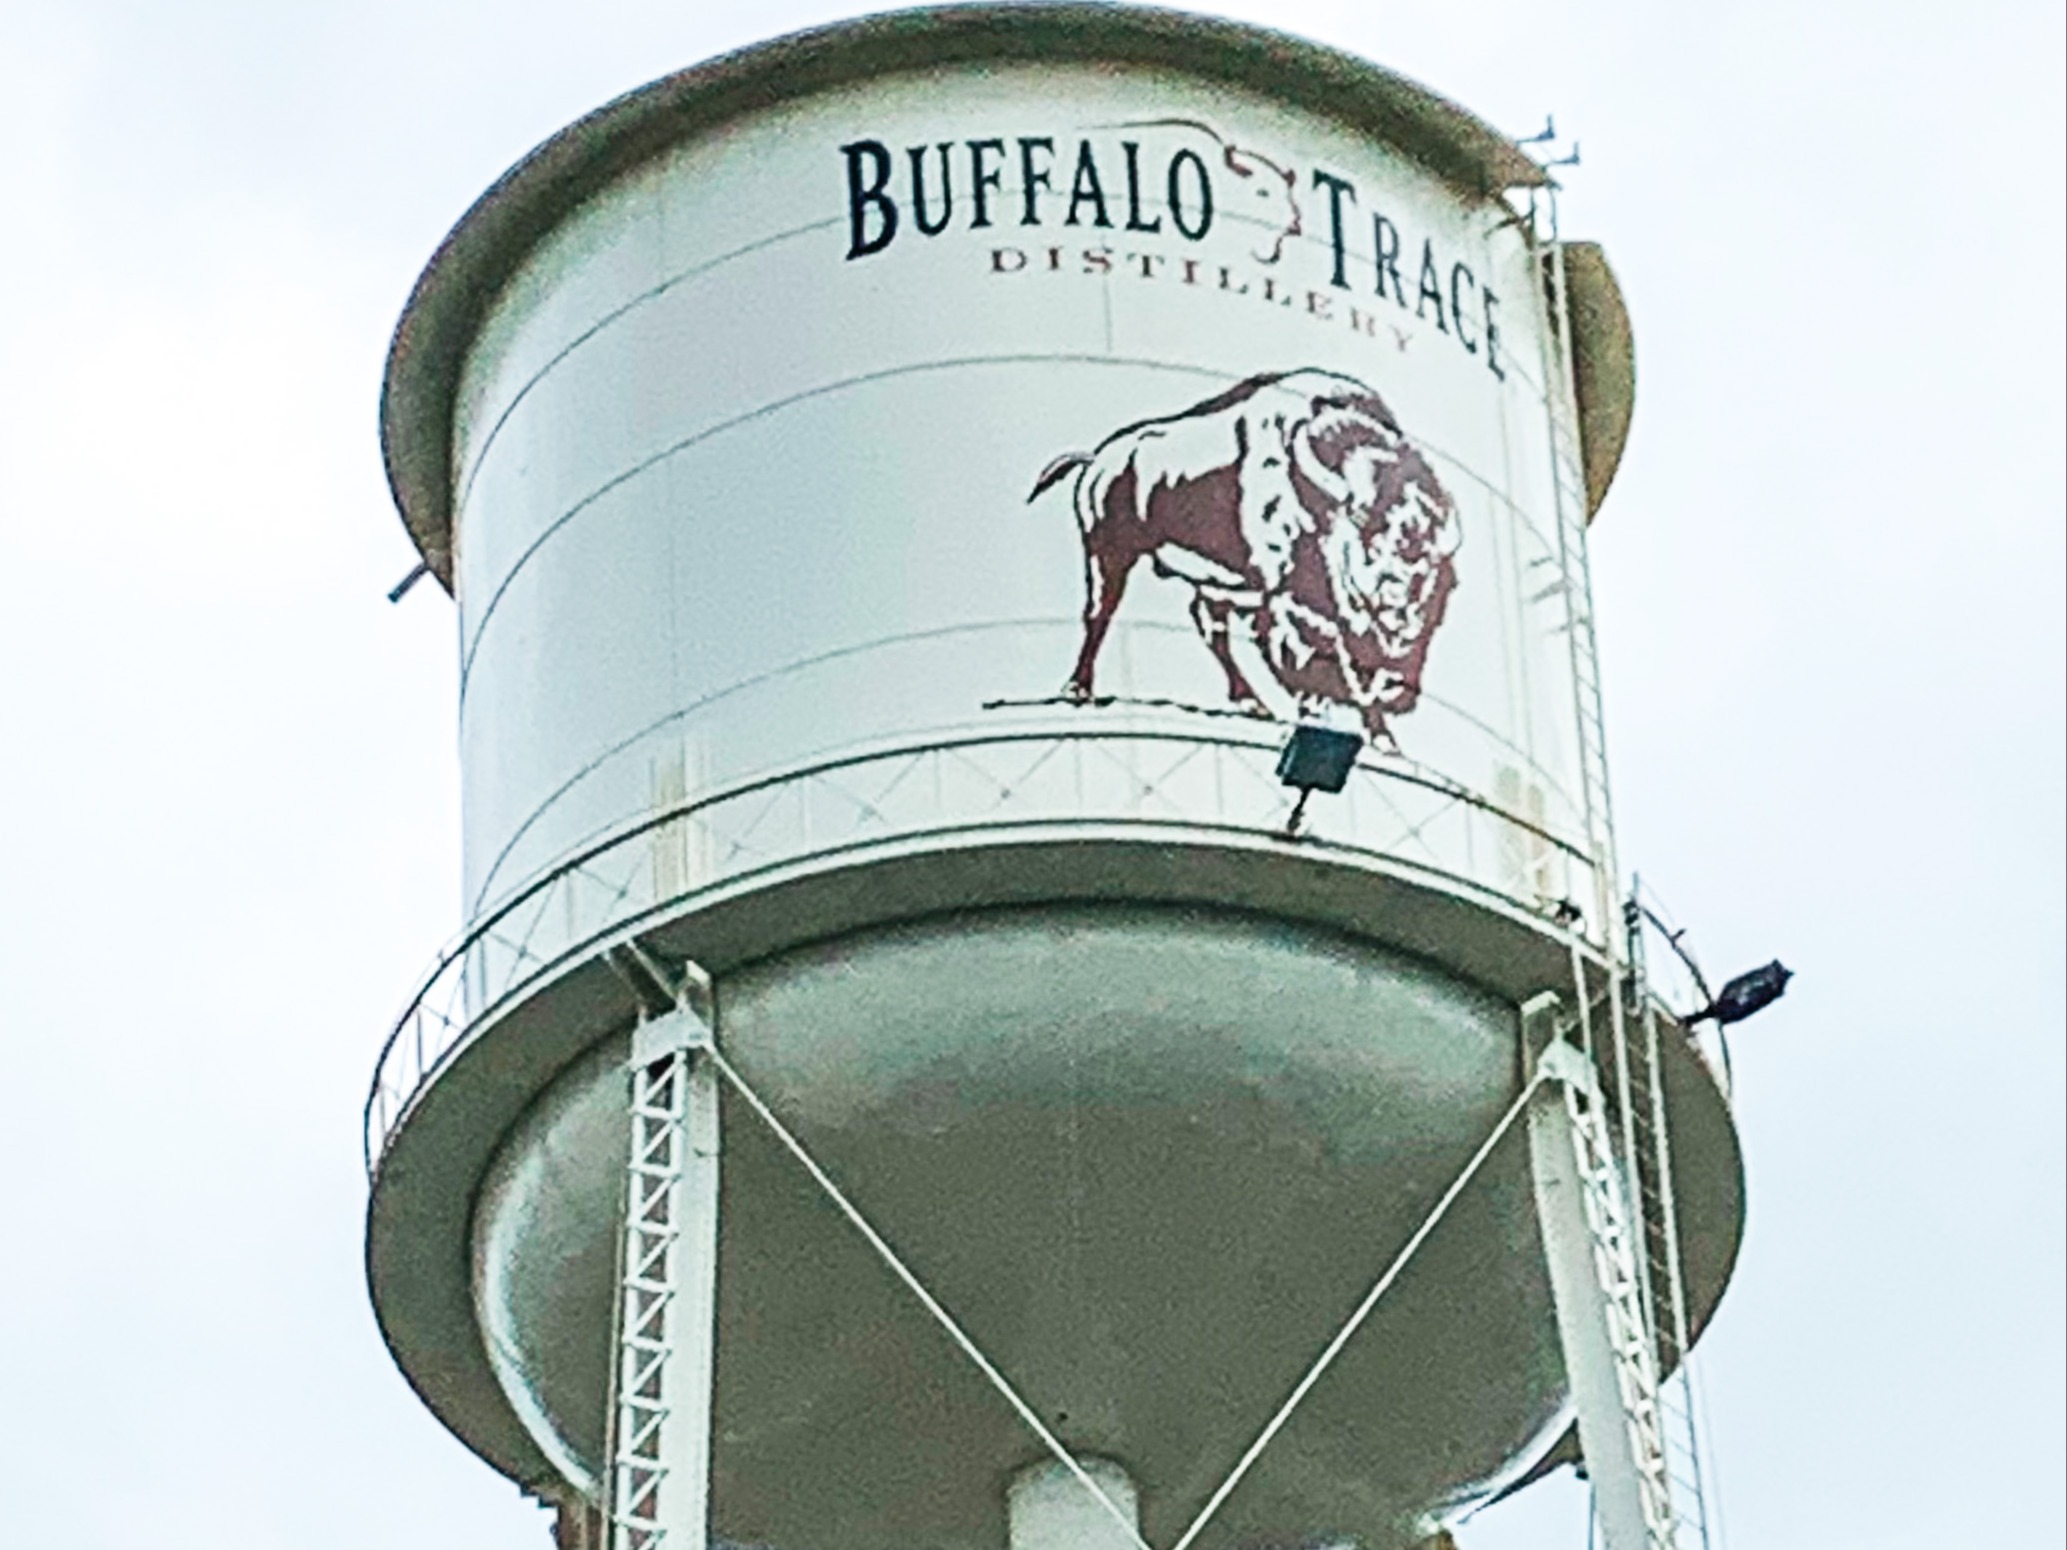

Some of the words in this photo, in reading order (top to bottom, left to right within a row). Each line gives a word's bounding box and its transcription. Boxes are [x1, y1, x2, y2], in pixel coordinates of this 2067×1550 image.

[839, 136, 1214, 261] BUFFALO
[1312, 168, 1505, 382] TRACE
[990, 246, 1413, 352] DISTILLERY
